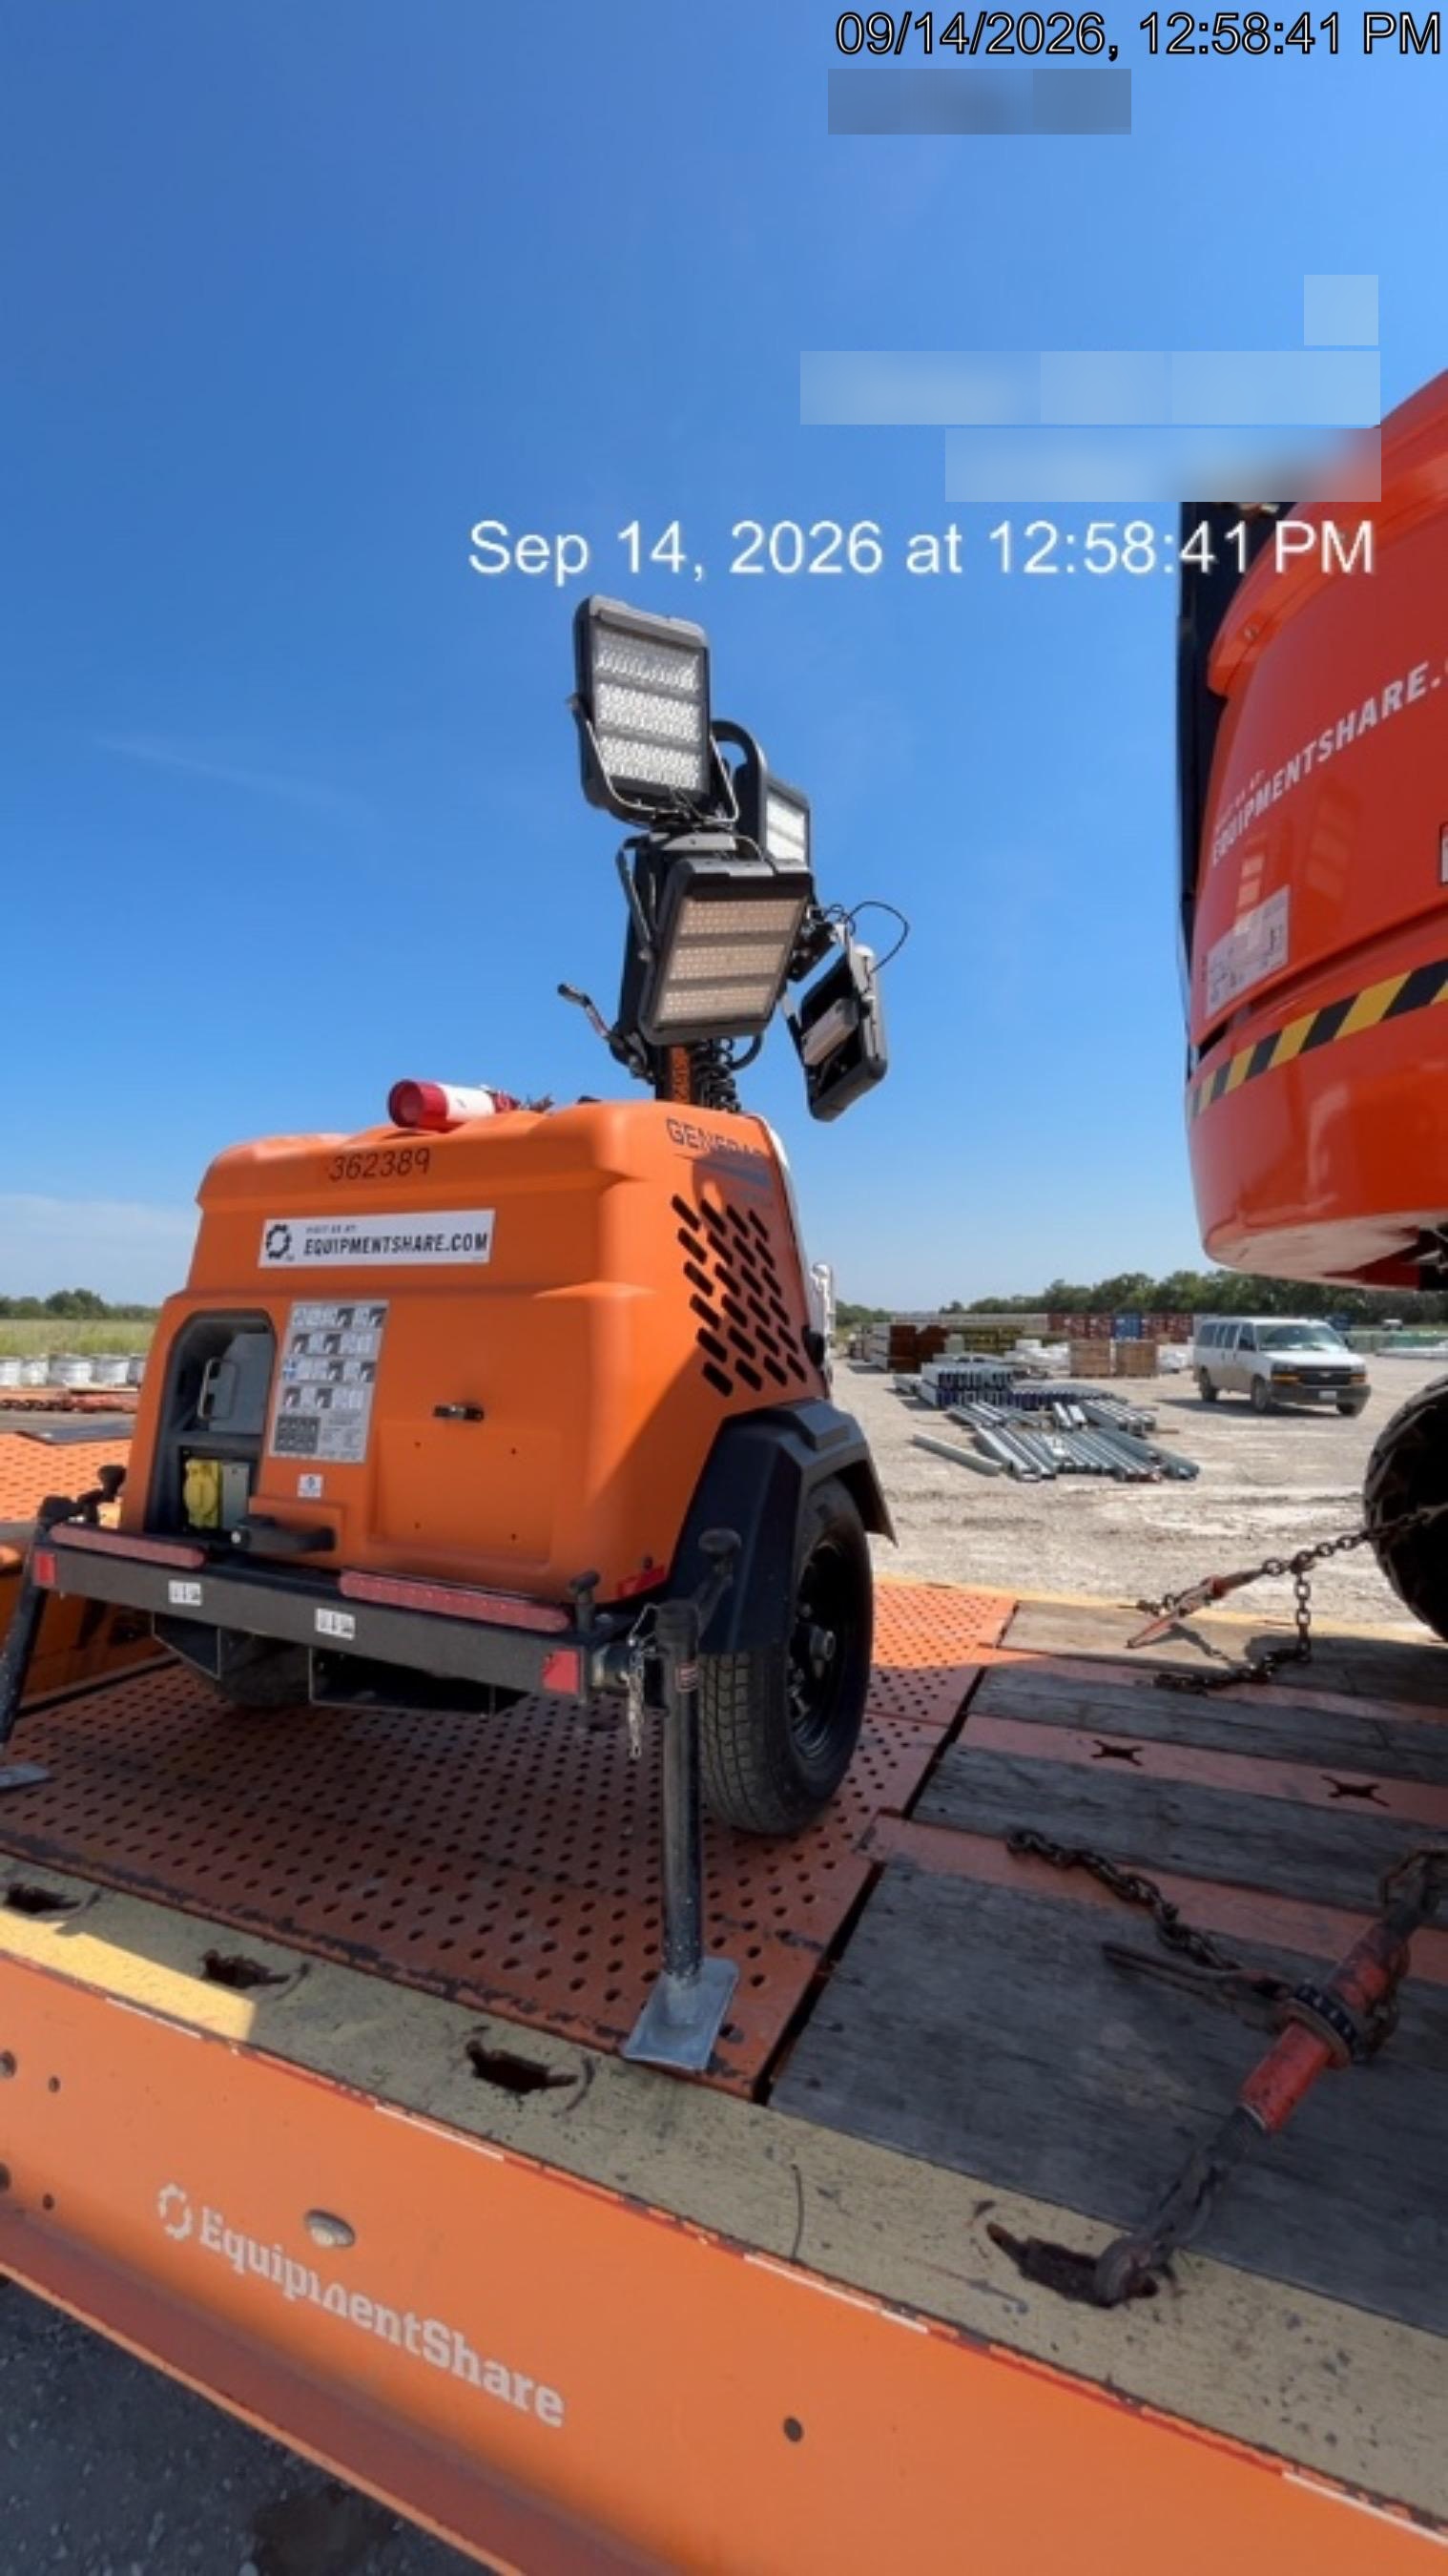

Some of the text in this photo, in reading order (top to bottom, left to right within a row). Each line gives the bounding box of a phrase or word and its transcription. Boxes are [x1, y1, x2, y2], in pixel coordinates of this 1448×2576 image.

[1212, 658, 1448, 866] EQUIPMENTSHARE.
[328, 1147, 430, 1182] 362389
[303, 1232, 488, 1257] EQUIPMENTSHARE.COM
[198, 2205, 565, 2427] EquipmentShare
